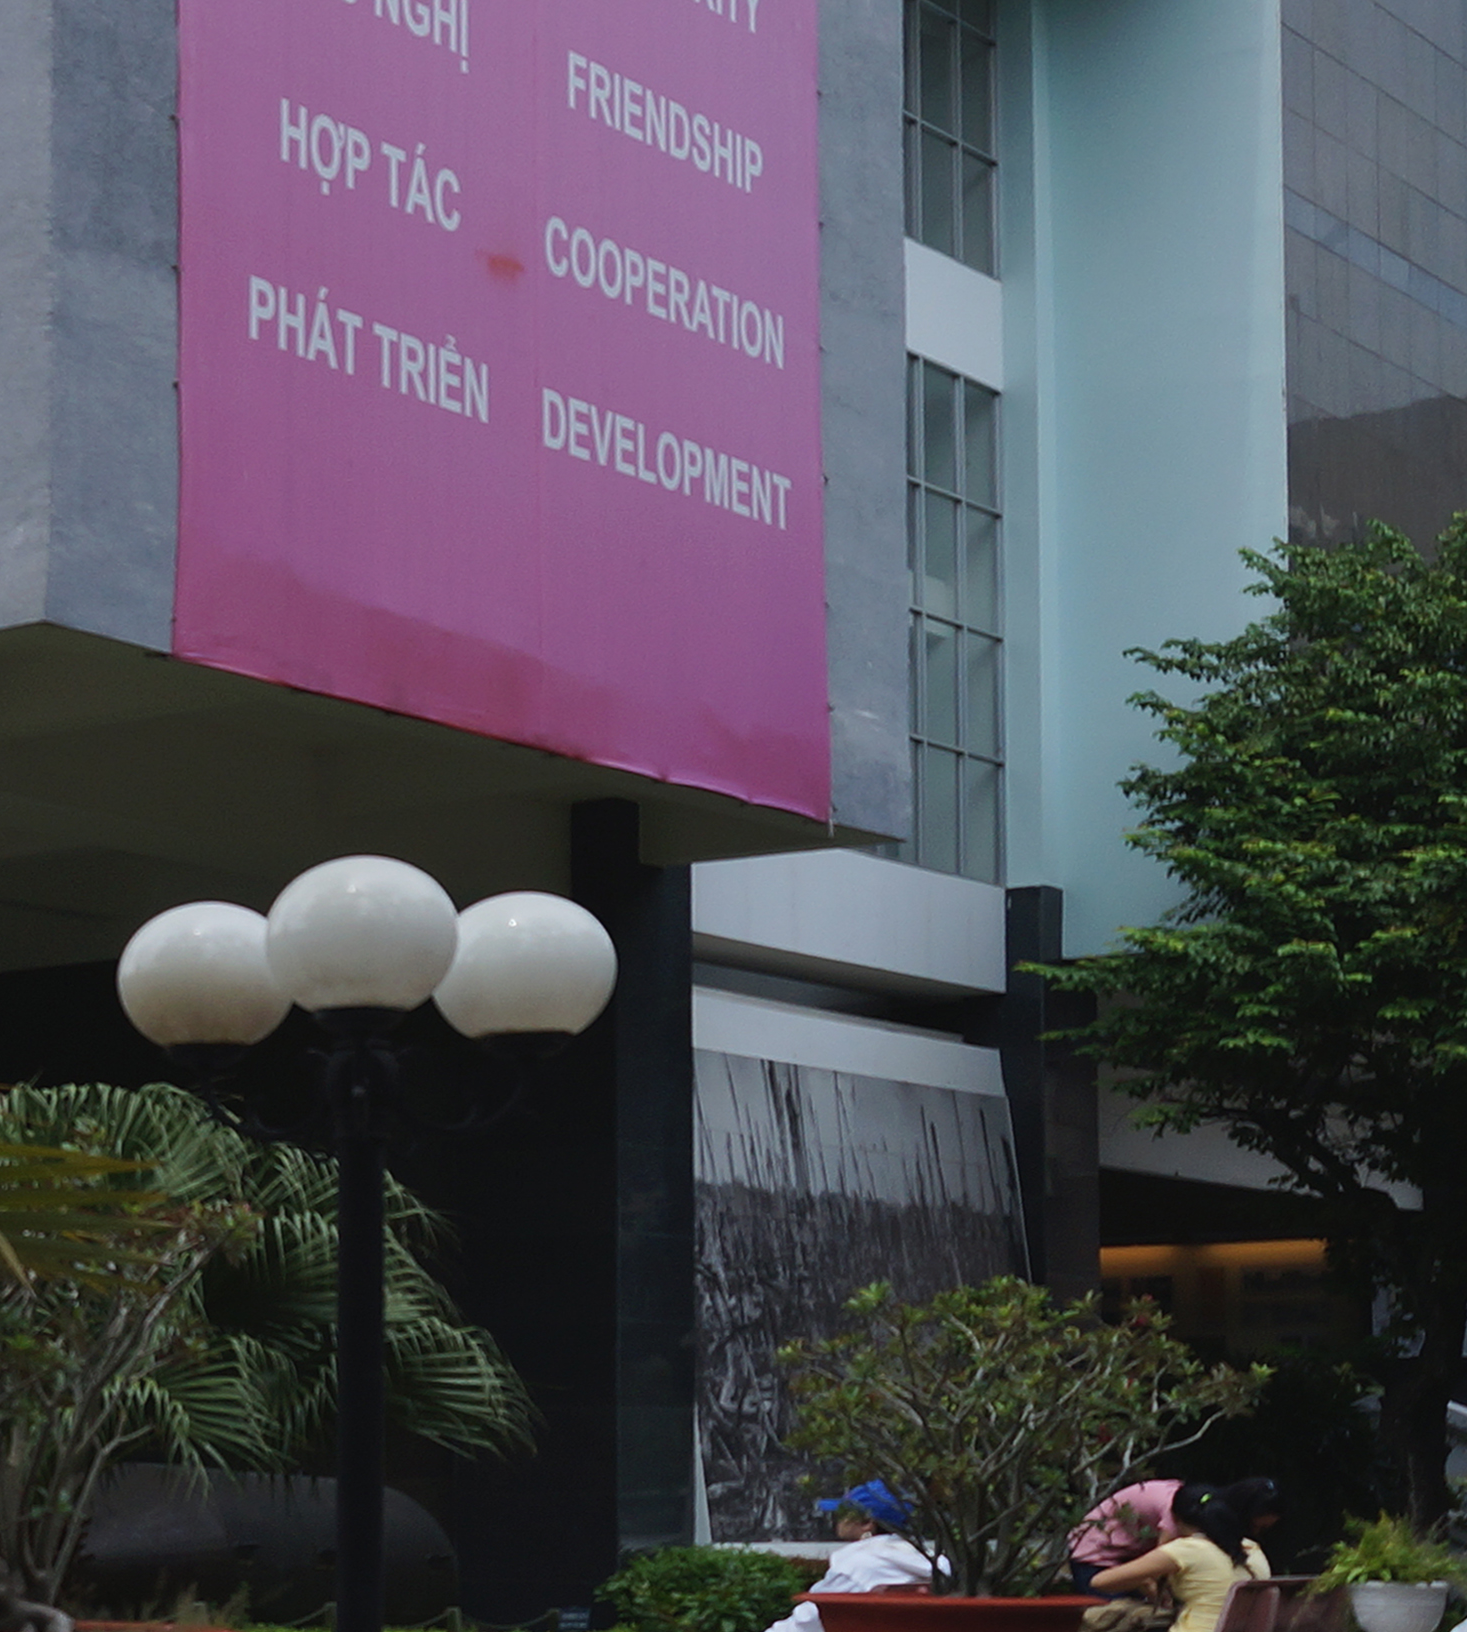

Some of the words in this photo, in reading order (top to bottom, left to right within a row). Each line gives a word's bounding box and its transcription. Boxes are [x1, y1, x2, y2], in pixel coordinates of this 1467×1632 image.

[280, 99, 371, 194] HỢP
[381, 143, 460, 231] TÁC
[567, 51, 764, 192] FRIENDSHIP
[250, 276, 363, 374] PHÁT
[373, 323, 488, 422] TRIỂN
[545, 217, 784, 369] COOPERATION
[542, 389, 791, 529] DEVELOPMENT
